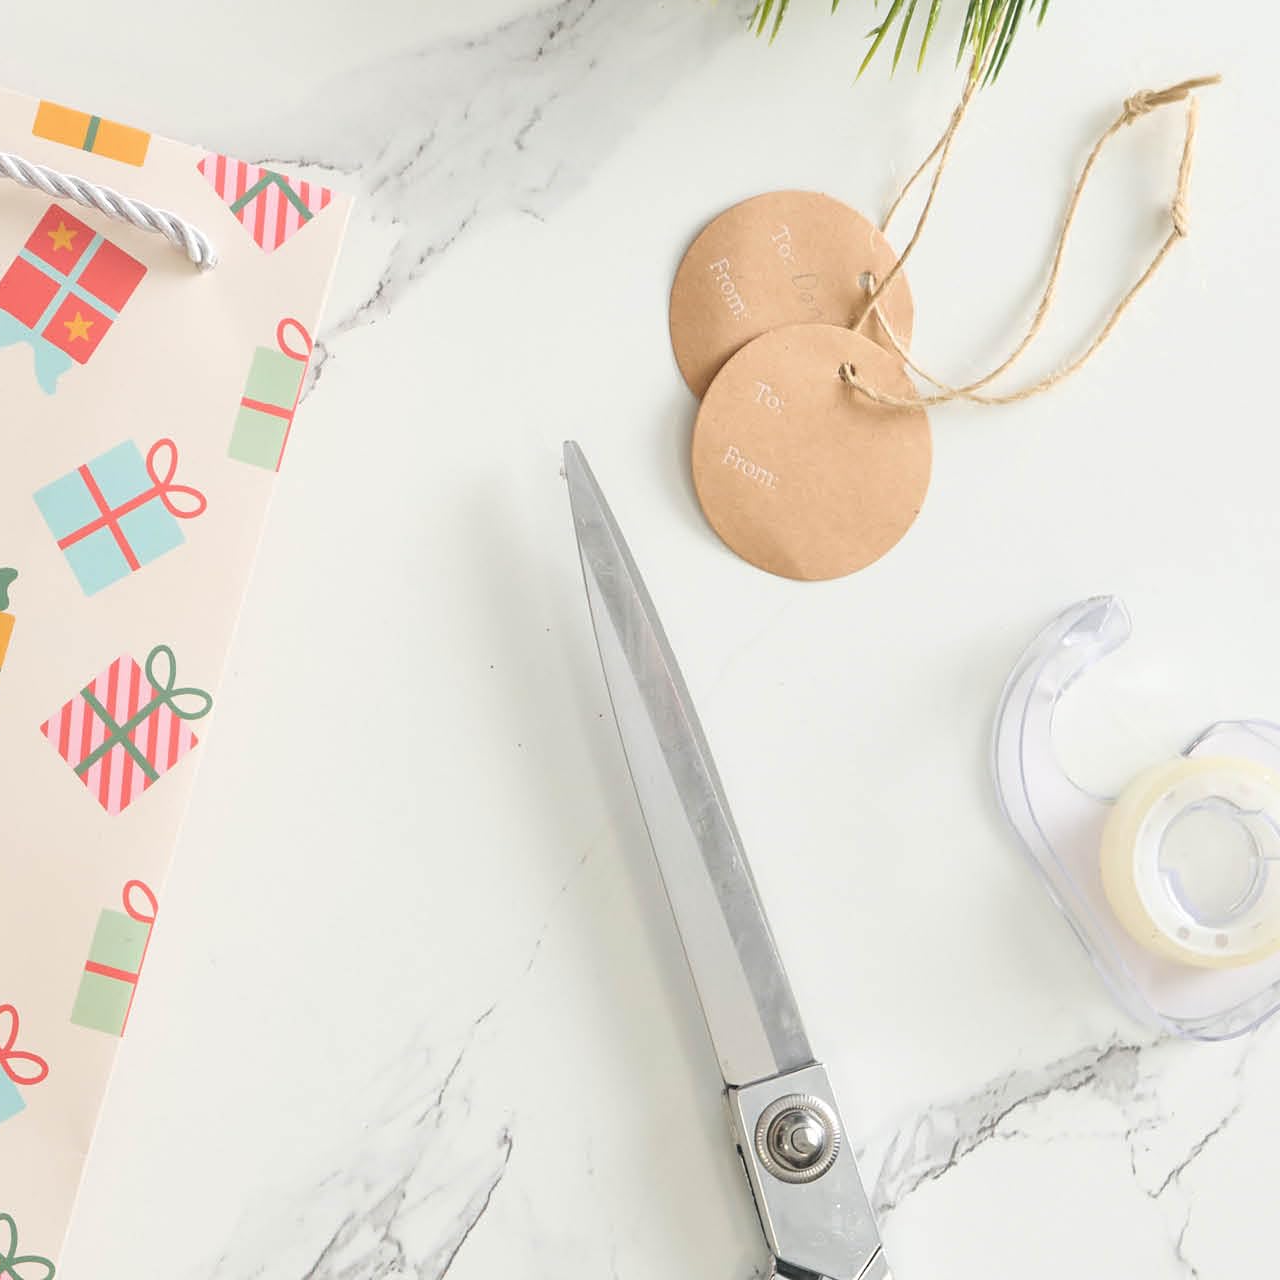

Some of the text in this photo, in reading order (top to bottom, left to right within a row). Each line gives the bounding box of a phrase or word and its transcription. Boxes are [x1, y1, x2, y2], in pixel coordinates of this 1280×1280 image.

[770, 224, 798, 265] To:
[709, 256, 752, 321] From:
[754, 380, 785, 415] To:
[721, 445, 780, 489] From:
